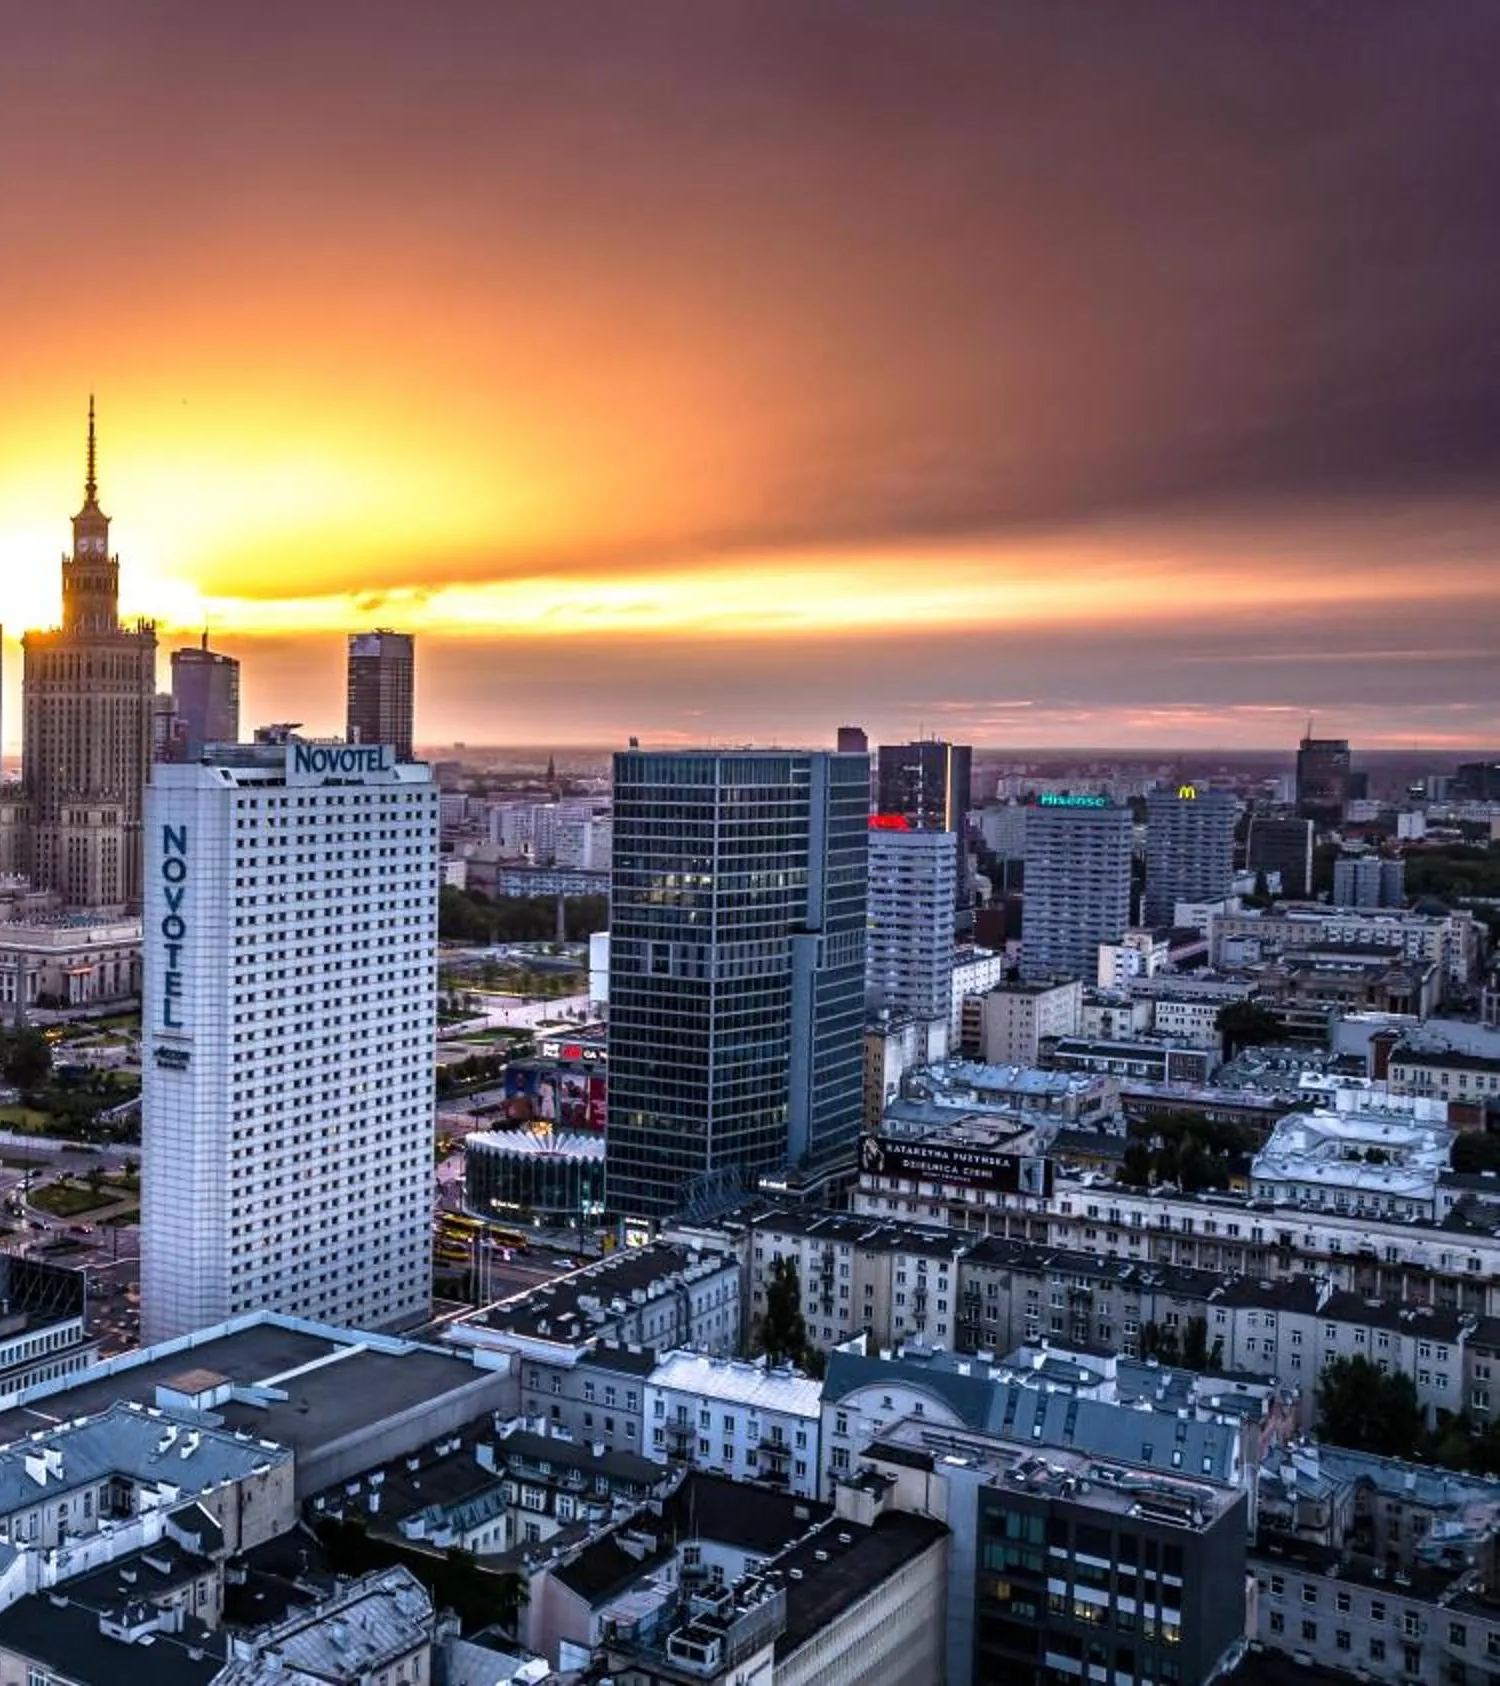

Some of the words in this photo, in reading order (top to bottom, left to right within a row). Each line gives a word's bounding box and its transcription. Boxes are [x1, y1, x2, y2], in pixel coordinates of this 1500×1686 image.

[295, 745, 390, 773] NOVOTEL
[1041, 792, 1105, 807] Hisense
[161, 824, 187, 1028] NOVOTEL
